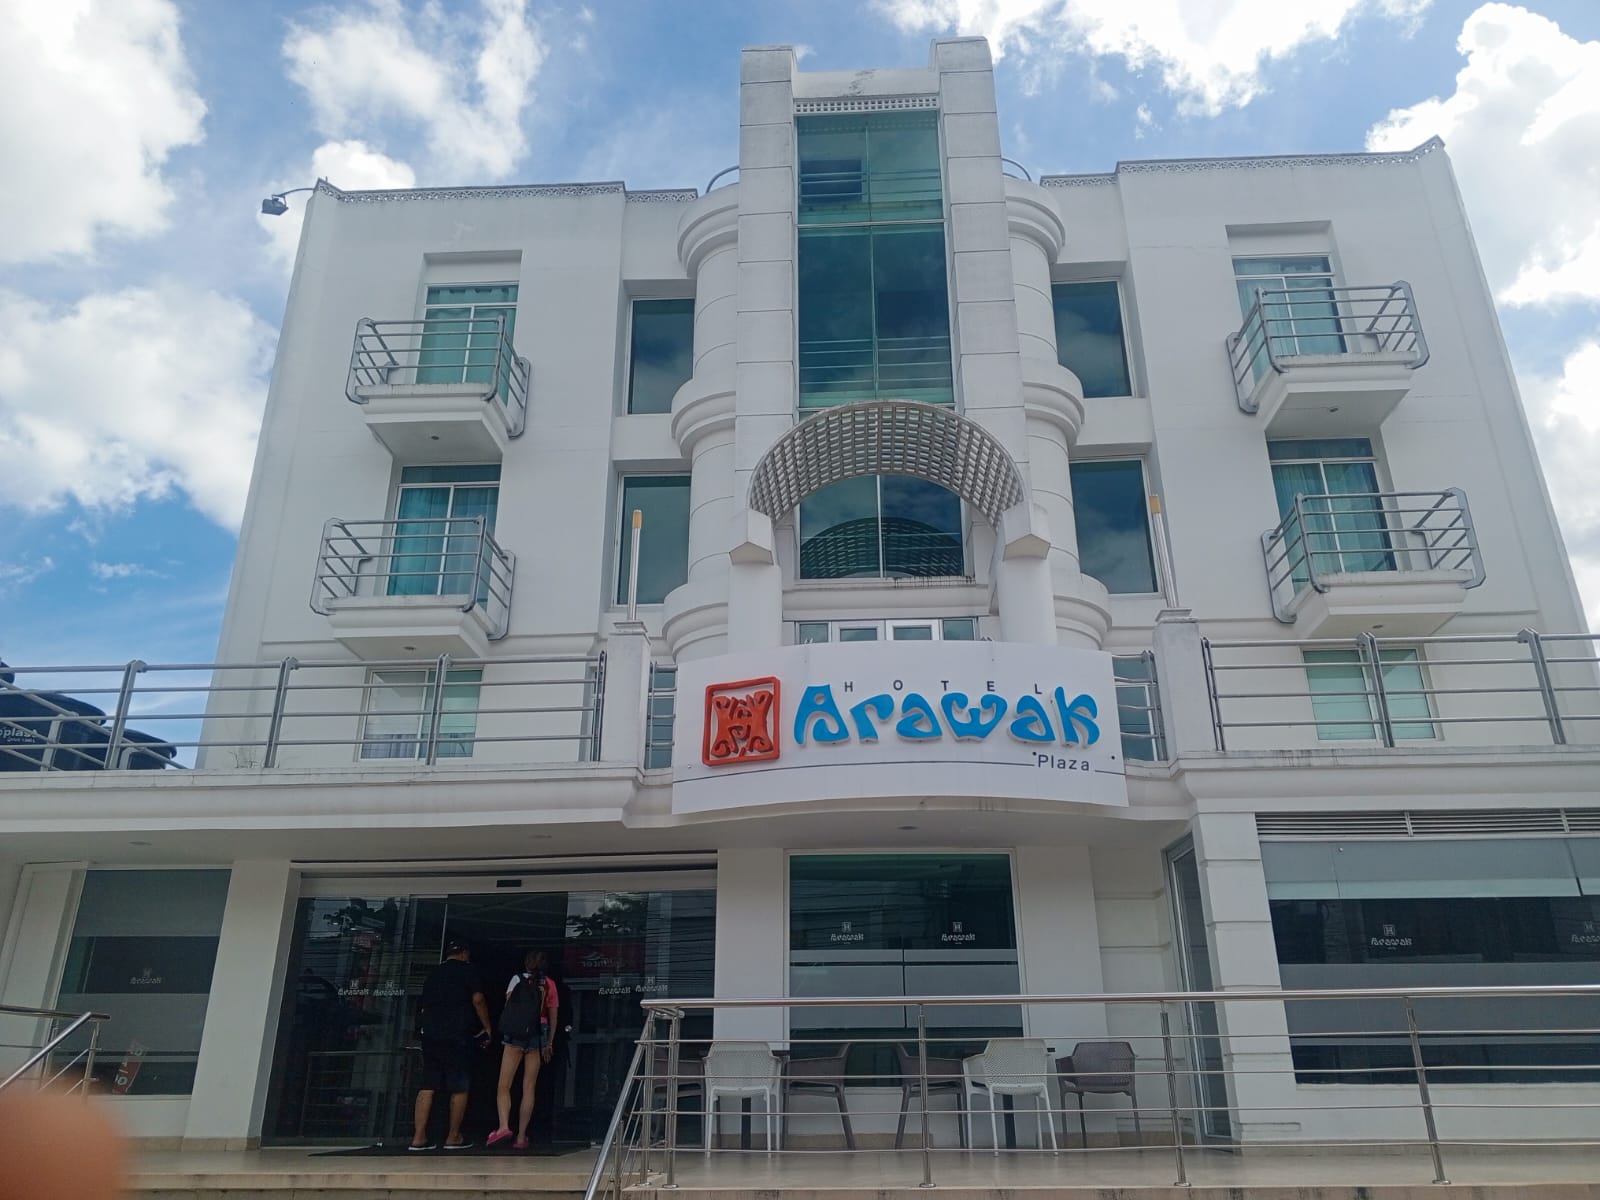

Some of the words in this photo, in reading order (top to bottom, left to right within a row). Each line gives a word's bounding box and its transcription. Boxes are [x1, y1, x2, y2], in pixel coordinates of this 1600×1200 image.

[844, 679, 1043, 696] HOTEL
[794, 683, 1101, 747] Arawak
[1037, 753, 1090, 771] Plaza
